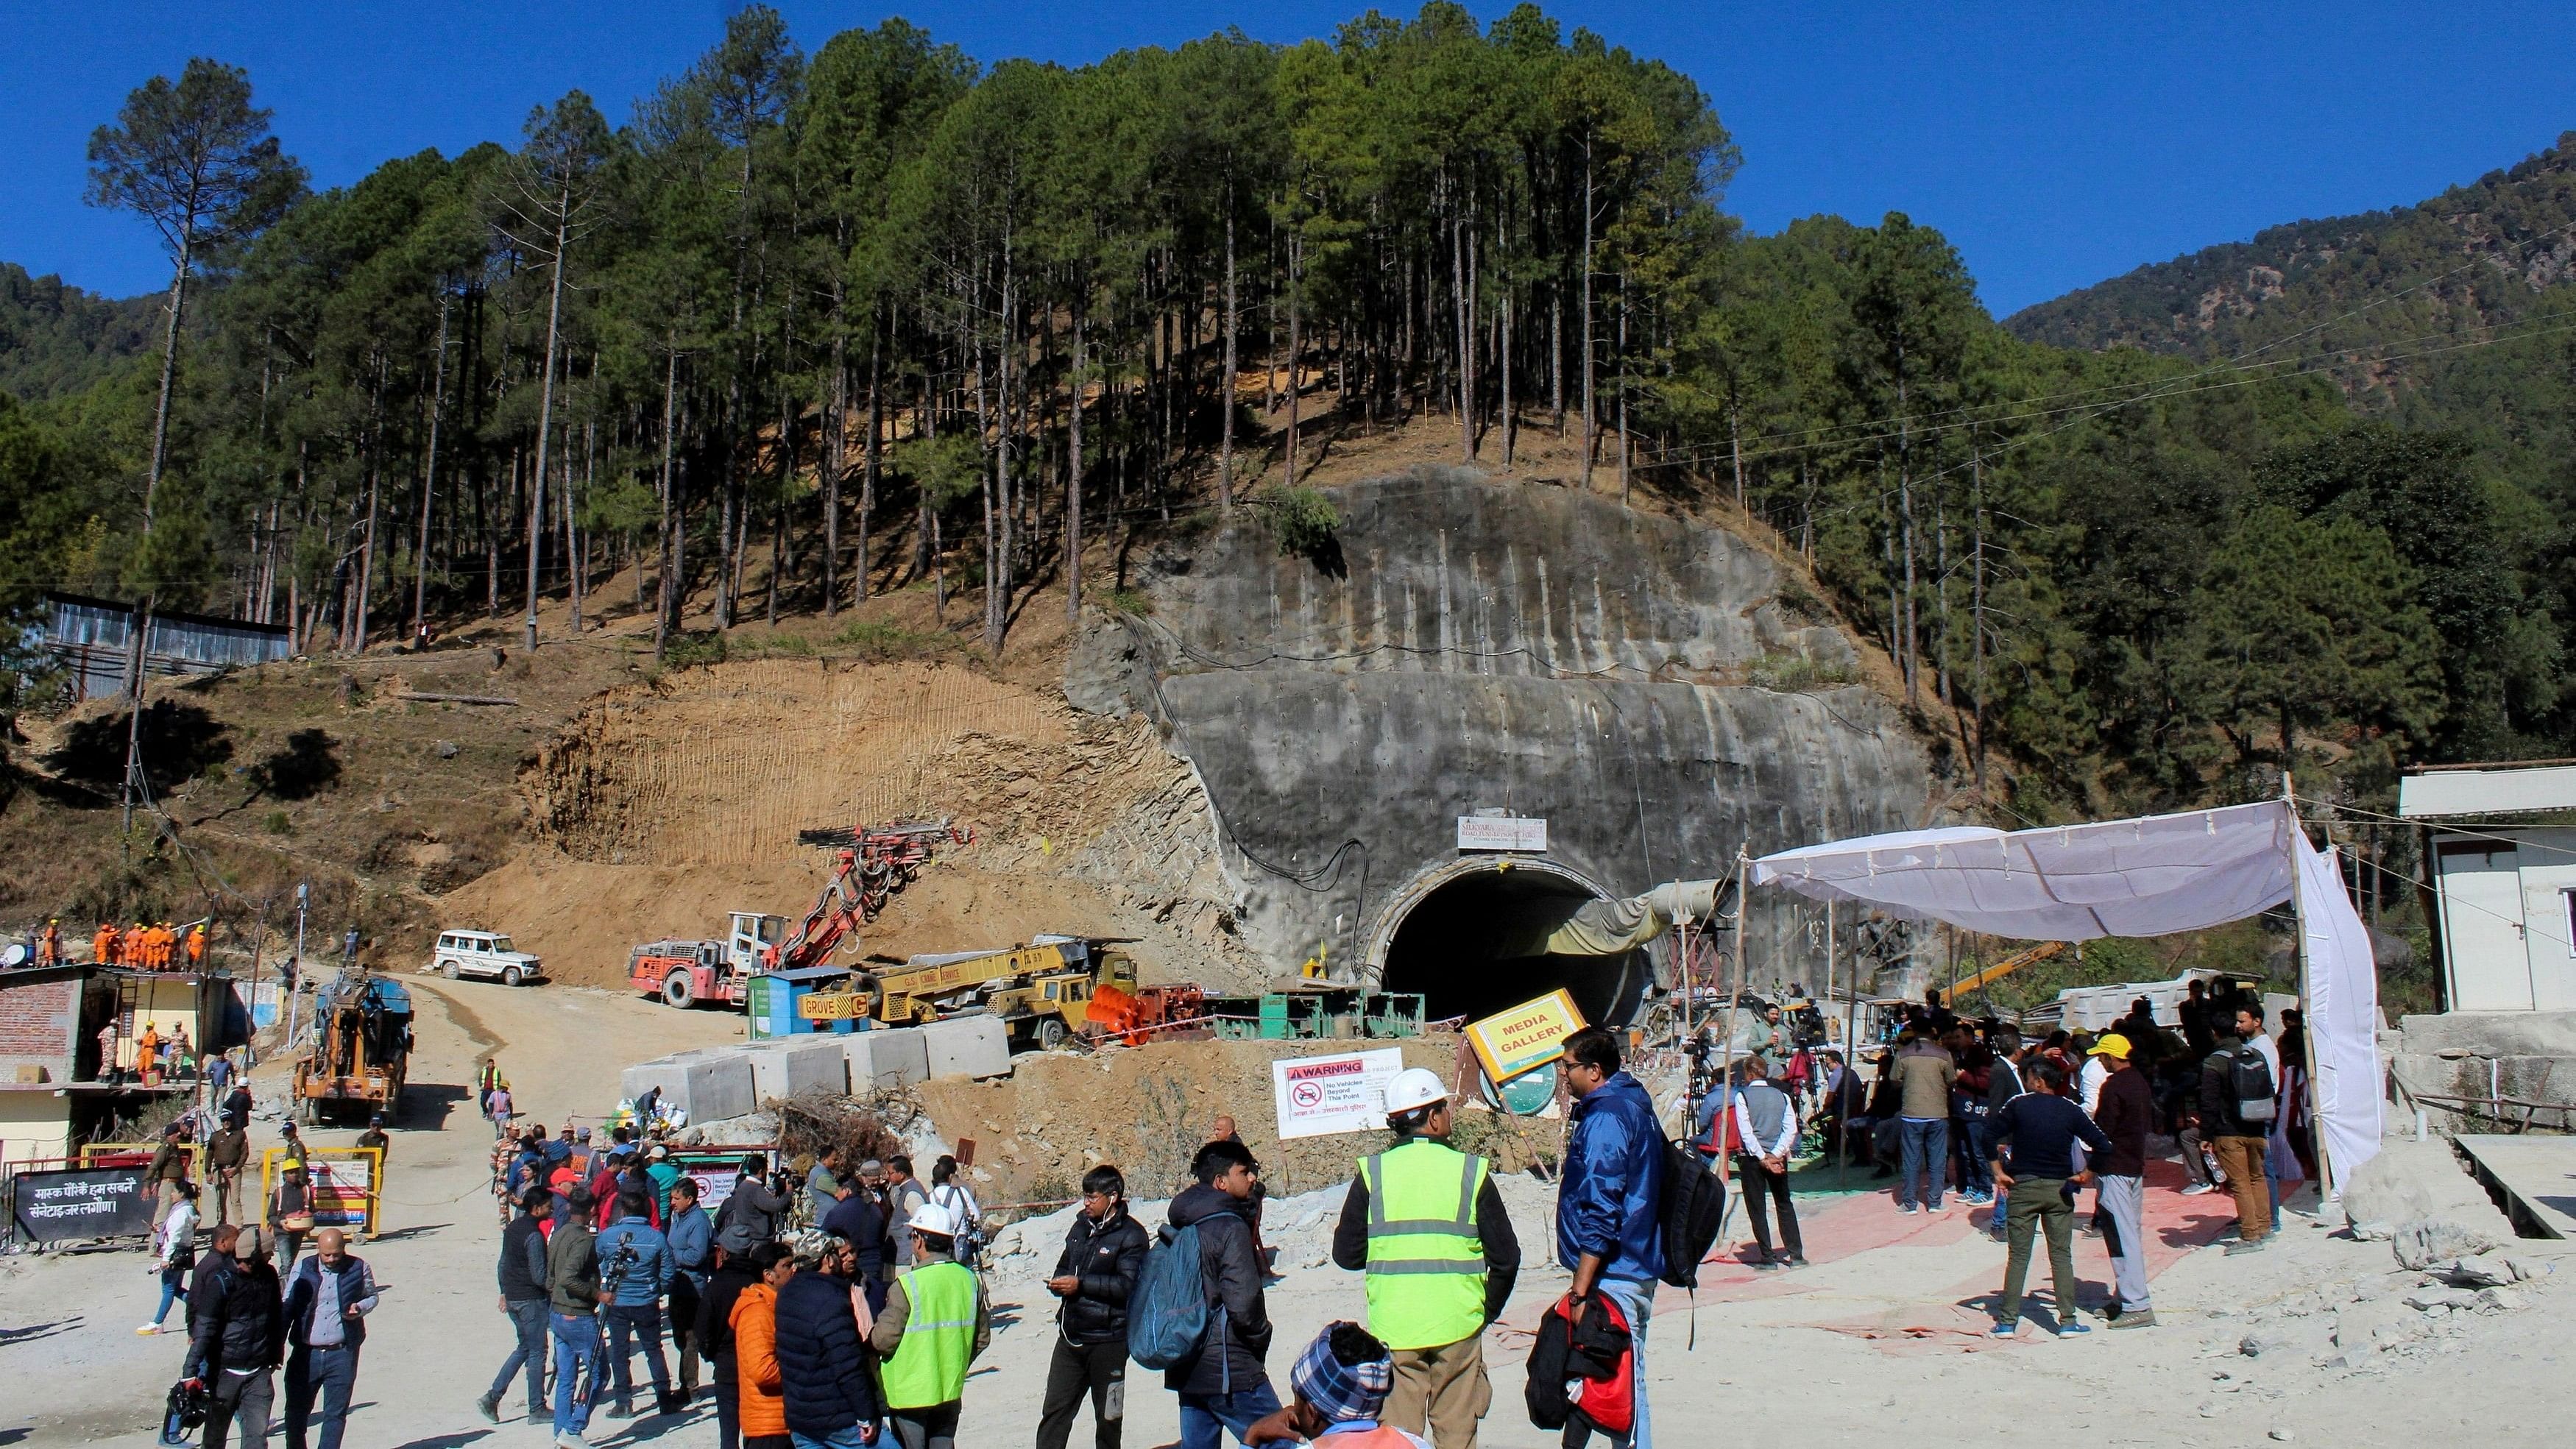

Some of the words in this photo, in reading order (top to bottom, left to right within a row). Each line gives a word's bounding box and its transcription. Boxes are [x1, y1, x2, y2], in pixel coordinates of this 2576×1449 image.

[806, 1000, 835, 1014] GROVE
[1502, 1014, 1549, 1035] MEDIA
[1501, 1024, 1563, 1052] GALLERY
[1303, 1062, 1362, 1077] WARNING
[1337, 1079, 1363, 1088] Vehicles
[1327, 1087, 1351, 1097] Beyond
[35, 1187, 63, 1200] मास्क
[88, 1183, 106, 1197] हम
